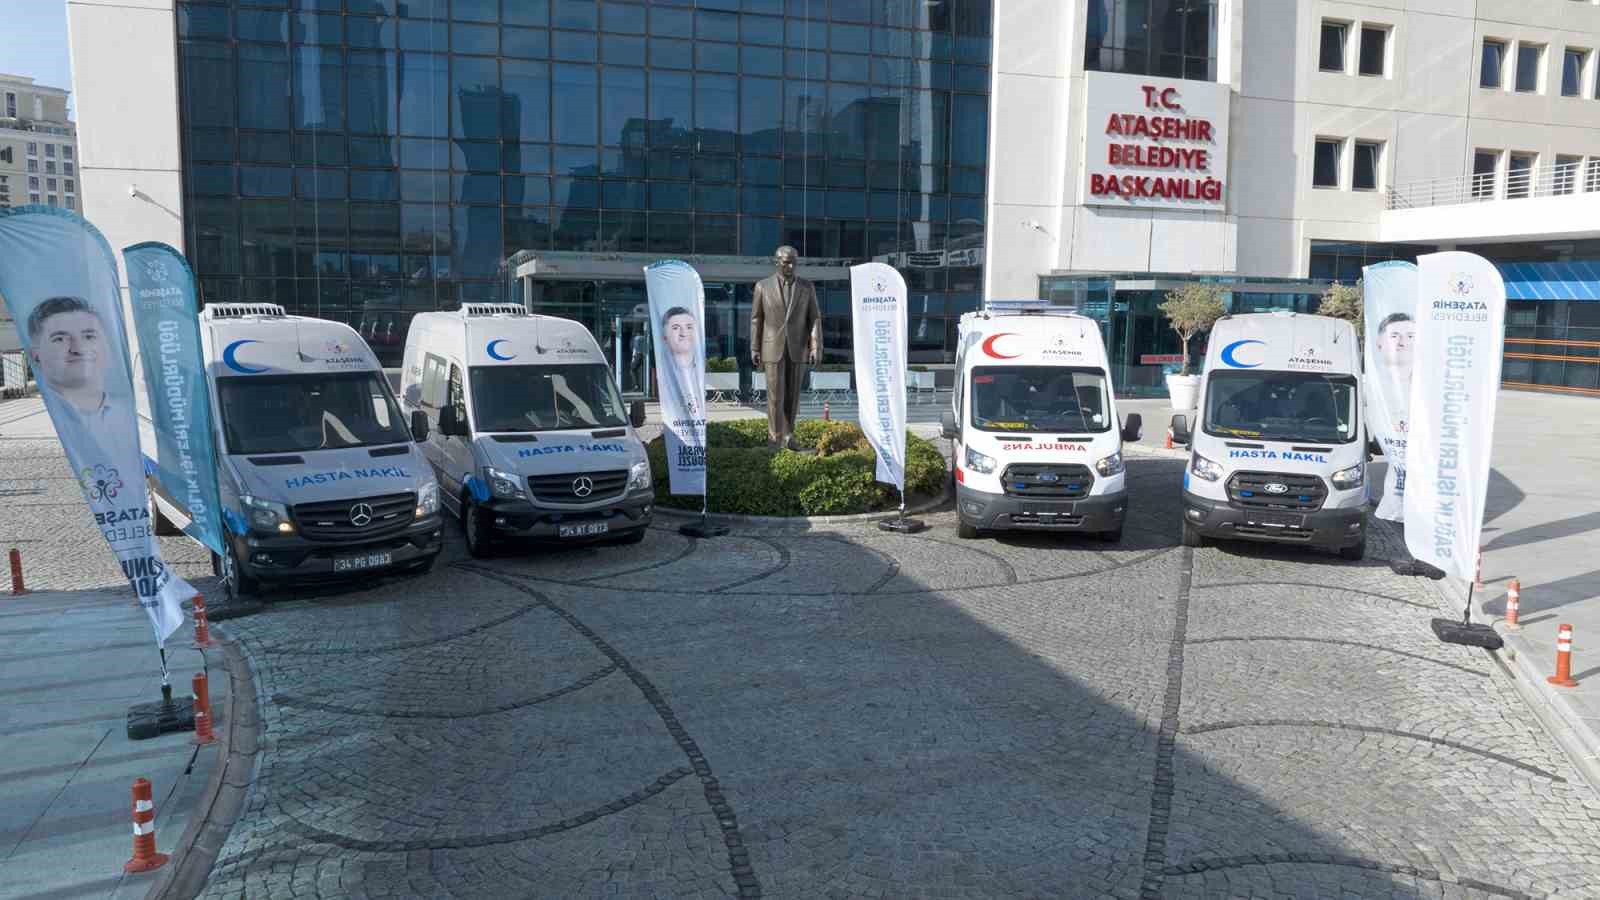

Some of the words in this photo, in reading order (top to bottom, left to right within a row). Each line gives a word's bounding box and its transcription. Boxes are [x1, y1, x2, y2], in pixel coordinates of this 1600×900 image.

[1142, 85, 1181, 110] T.C.
[1105, 113, 1212, 142] ATAŞEHİR
[1108, 143, 1207, 170] BELEDİYE
[1090, 173, 1222, 201] BAŞKANLIĞI
[518, 445, 575, 458] HASTA
[1230, 450, 1277, 459] HASTA
[1283, 452, 1328, 463] NAKİL
[286, 470, 351, 489] HASTA
[354, 466, 412, 478] NAKİL
